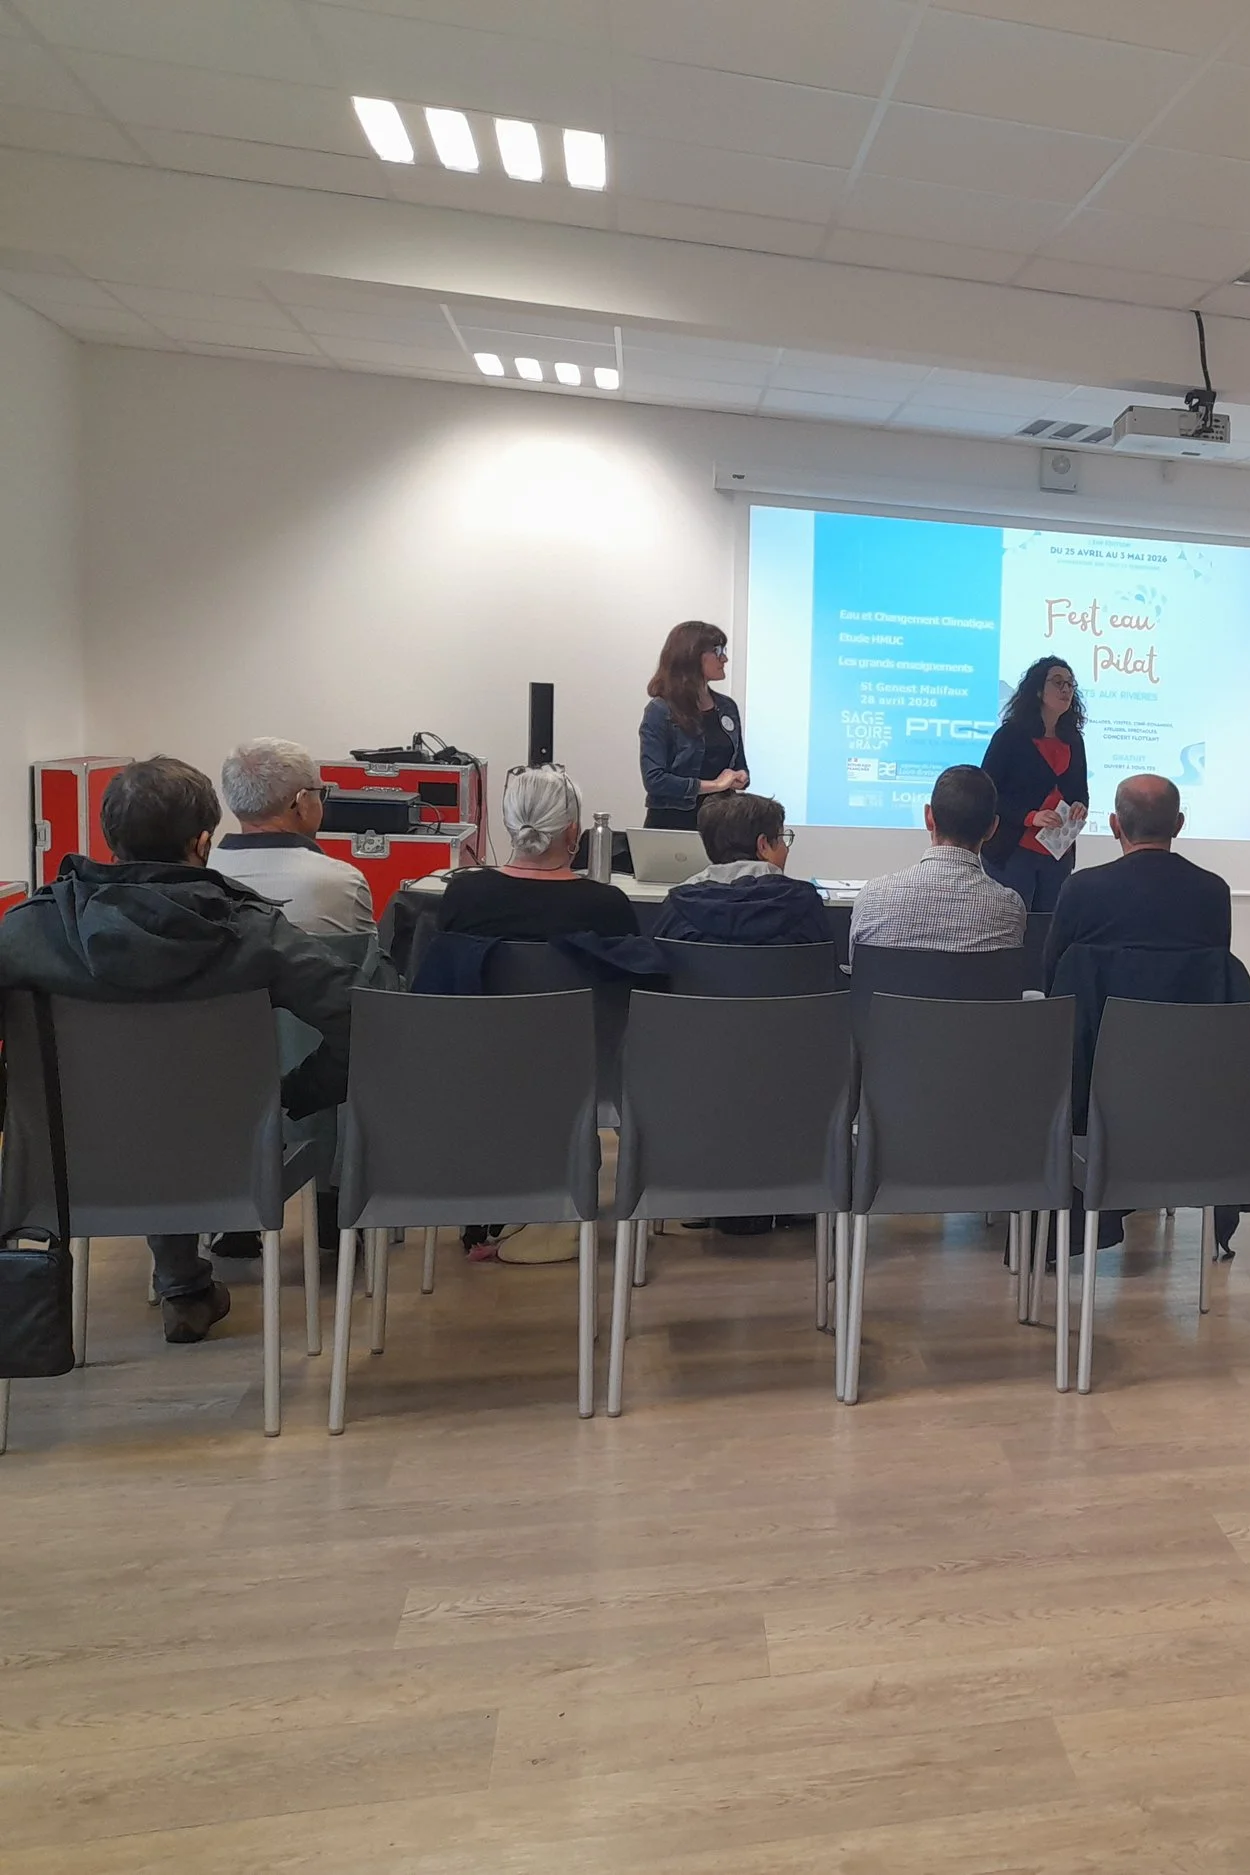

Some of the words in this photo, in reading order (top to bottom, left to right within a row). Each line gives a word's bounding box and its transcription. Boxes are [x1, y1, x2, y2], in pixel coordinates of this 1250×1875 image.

[1050, 546, 1063, 555] DU
[1065, 547, 1075, 556] 25
[1077, 549, 1104, 558] AVRIL
[1105, 551, 1118, 559] AU
[1127, 553, 1145, 561] MAI
[1147, 554, 1168, 563] 2026
[839, 609, 860, 621] Eau
[861, 611, 873, 621] et
[874, 612, 940, 626] Changement
[942, 616, 995, 630] Climatique
[1044, 598, 1103, 638] Fest
[1109, 614, 1155, 631] eau
[838, 656, 857, 667] Les
[858, 658, 895, 670] grands
[1093, 645, 1160, 684] Pilat
[860, 681, 873, 692] St
[875, 683, 917, 694] Genest
[919, 685, 969, 697] Malifaux
[878, 696, 905, 706] avril
[907, 697, 938, 708] 2026
[841, 710, 886, 726] SAGE
[846, 725, 893, 740] LOIRE
